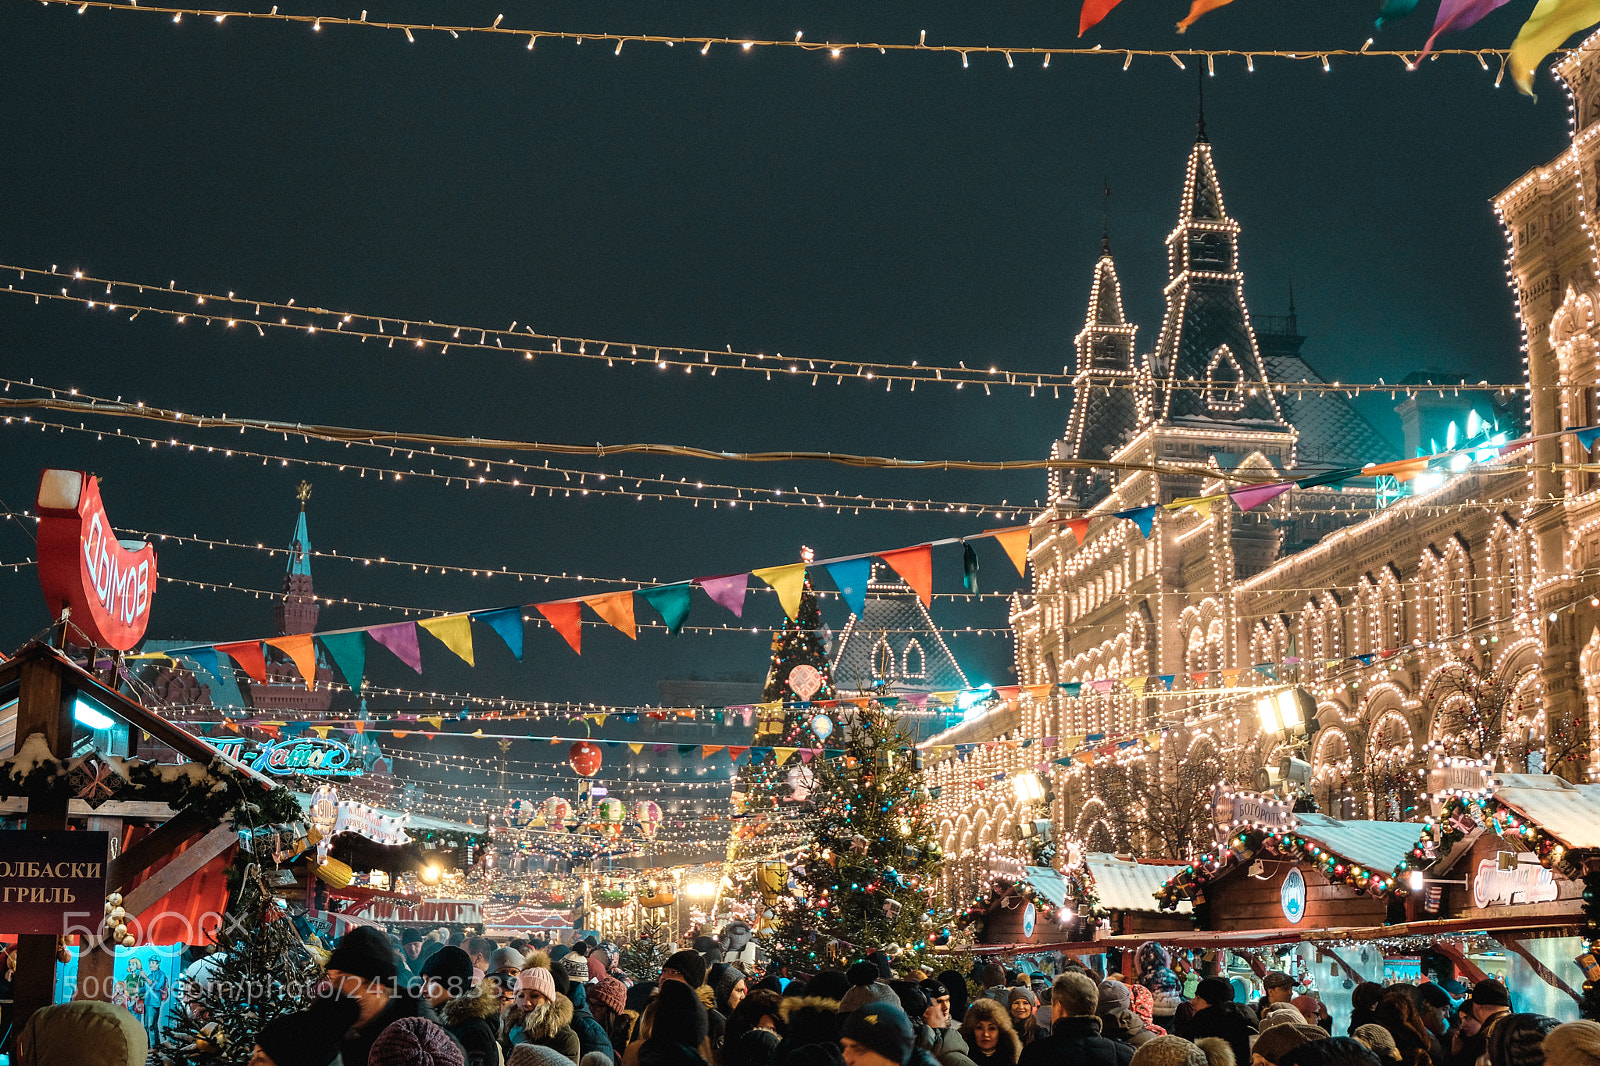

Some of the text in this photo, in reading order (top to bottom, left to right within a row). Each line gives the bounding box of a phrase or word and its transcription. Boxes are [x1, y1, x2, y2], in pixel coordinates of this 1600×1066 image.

[84, 512, 149, 624] ДЫМОВ
[349, 806, 382, 828] КАШТАНЫ
[2, 886, 76, 904] ГРИЛЬ
